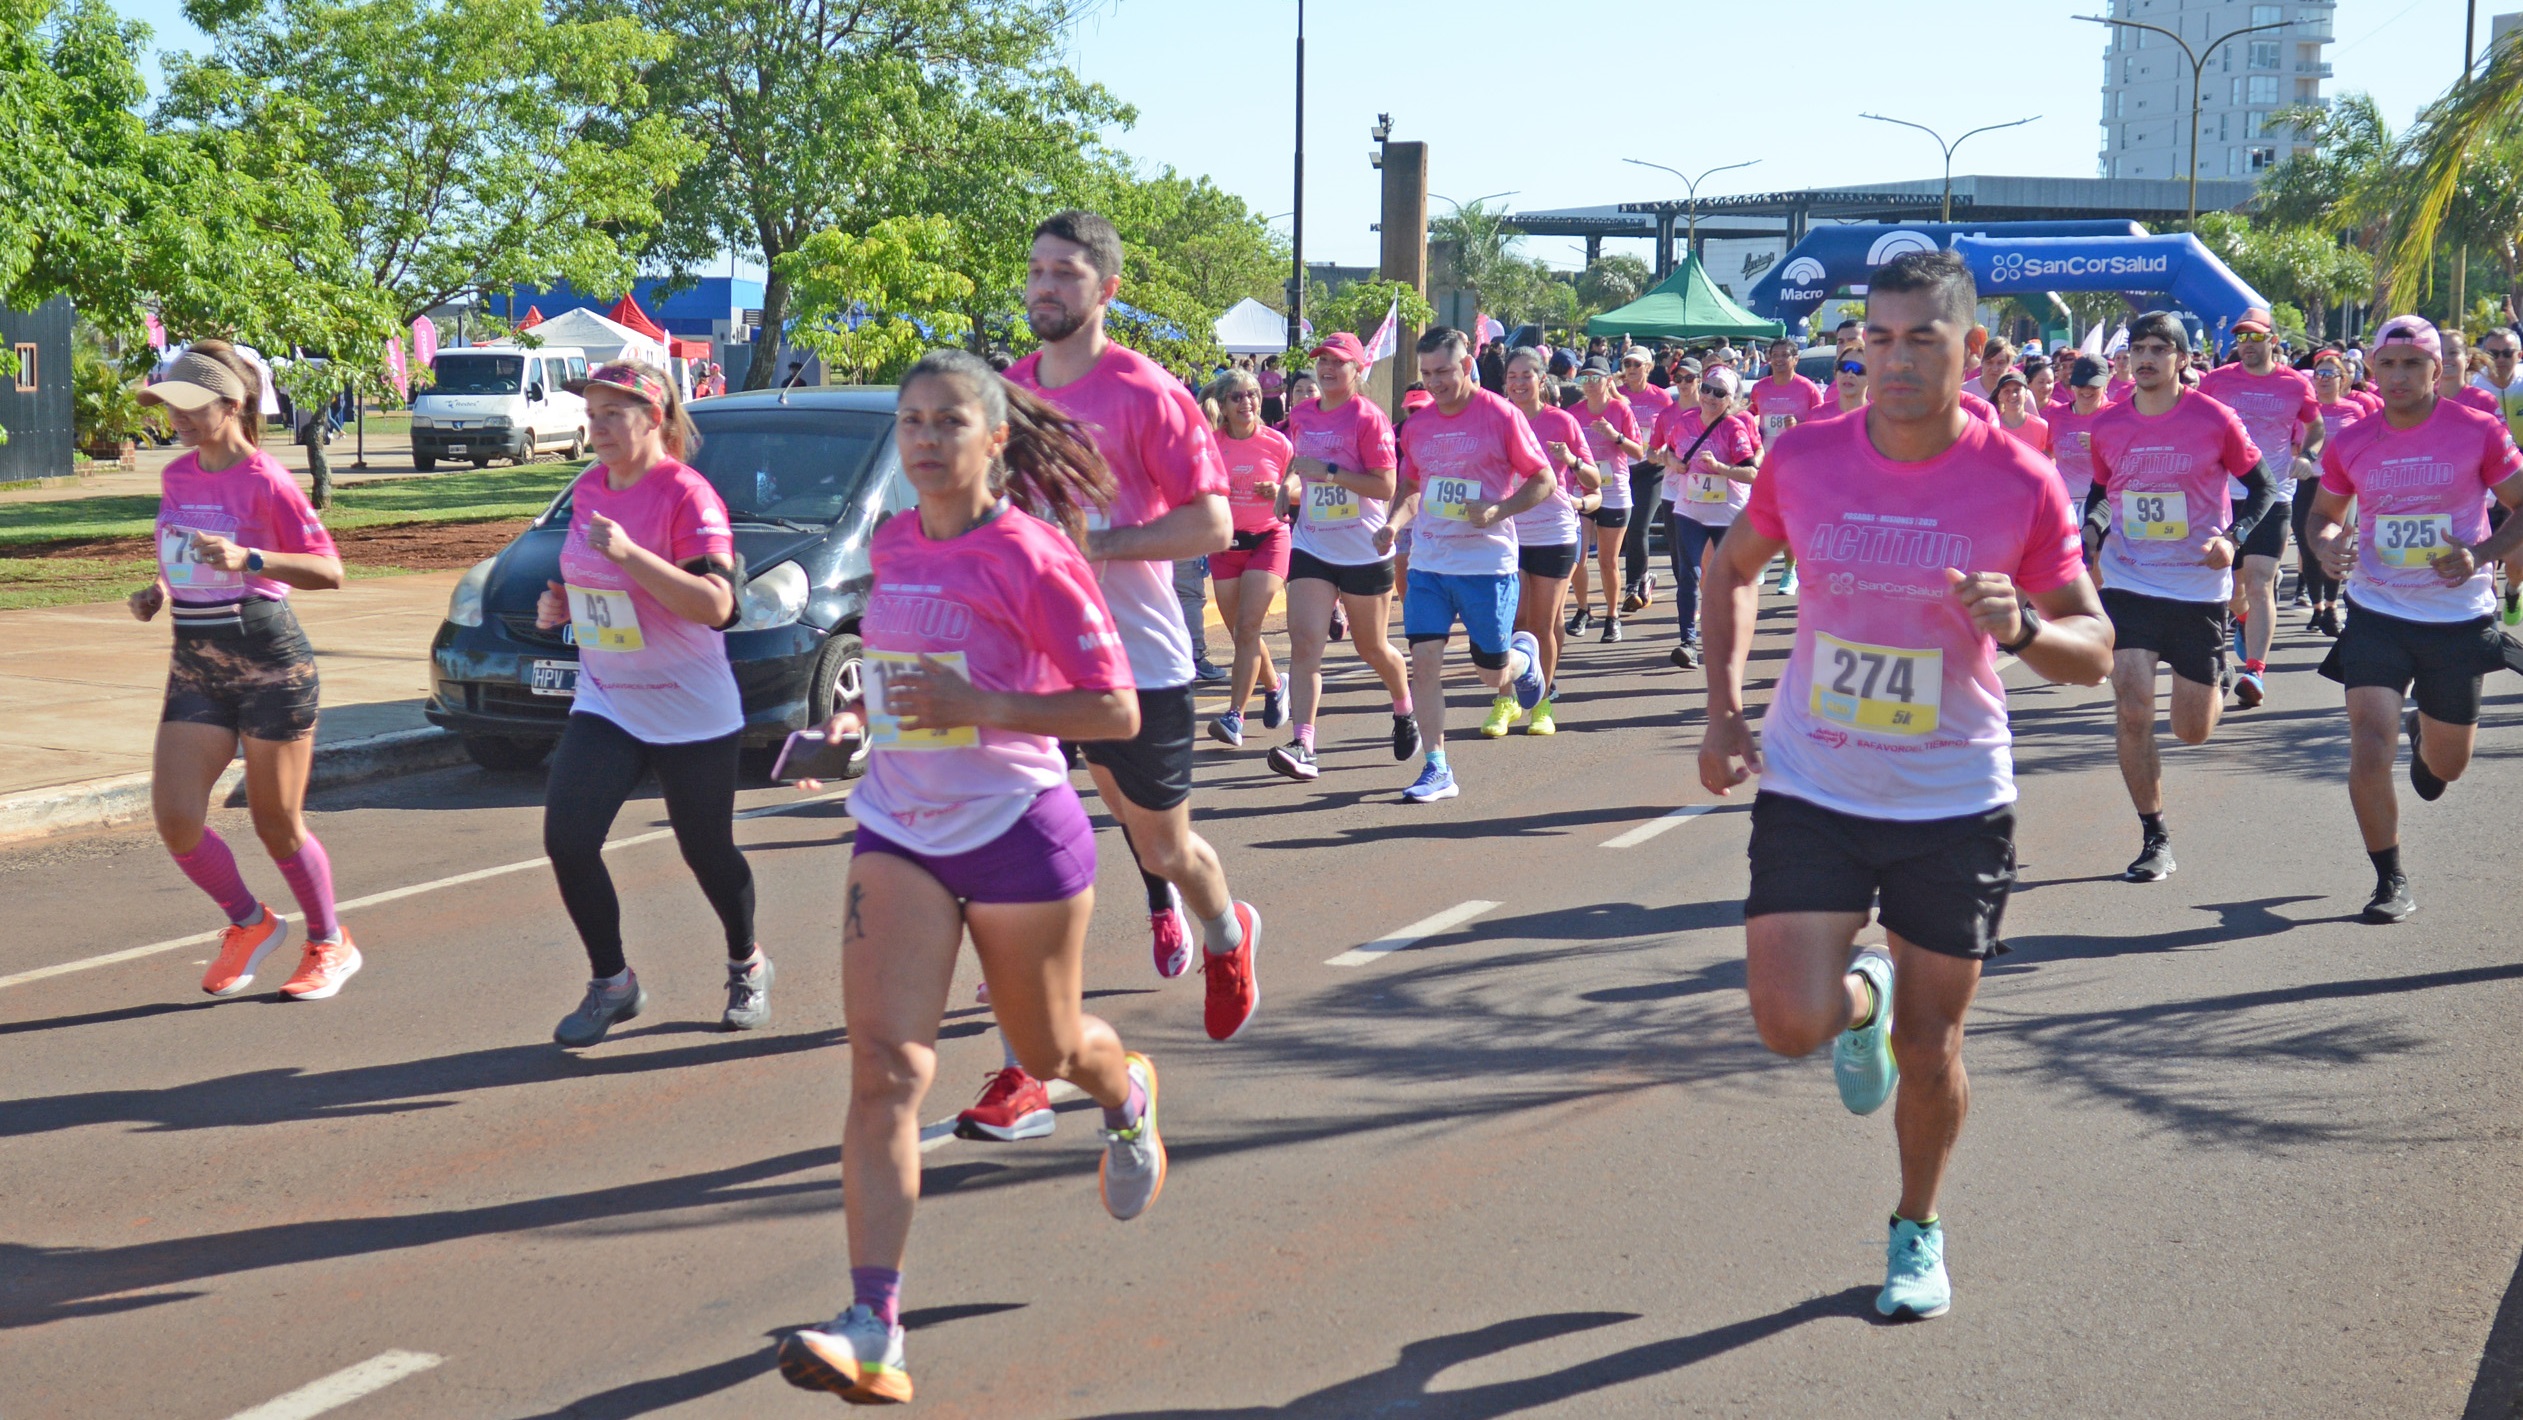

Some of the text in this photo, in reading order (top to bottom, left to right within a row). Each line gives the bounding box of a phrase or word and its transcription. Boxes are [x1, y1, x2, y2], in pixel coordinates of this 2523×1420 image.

[2024, 255, 2167, 276] SanCorSalud
[1781, 288, 1824, 301] Macro
[2117, 453, 2193, 477] ACTITUD
[1702, 477, 1711, 492] 4
[2364, 463, 2454, 492] ACTITUD
[1314, 486, 1347, 507] 258
[1436, 481, 1467, 504] 199
[2136, 497, 2165, 522] 93
[2387, 520, 2436, 549] 325
[1807, 523, 1973, 574] ACTITUD
[1857, 579, 1944, 598] SanCorSalud
[584, 593, 612, 628] 43
[534, 669, 564, 689] HPV
[1832, 647, 1915, 703] 274
